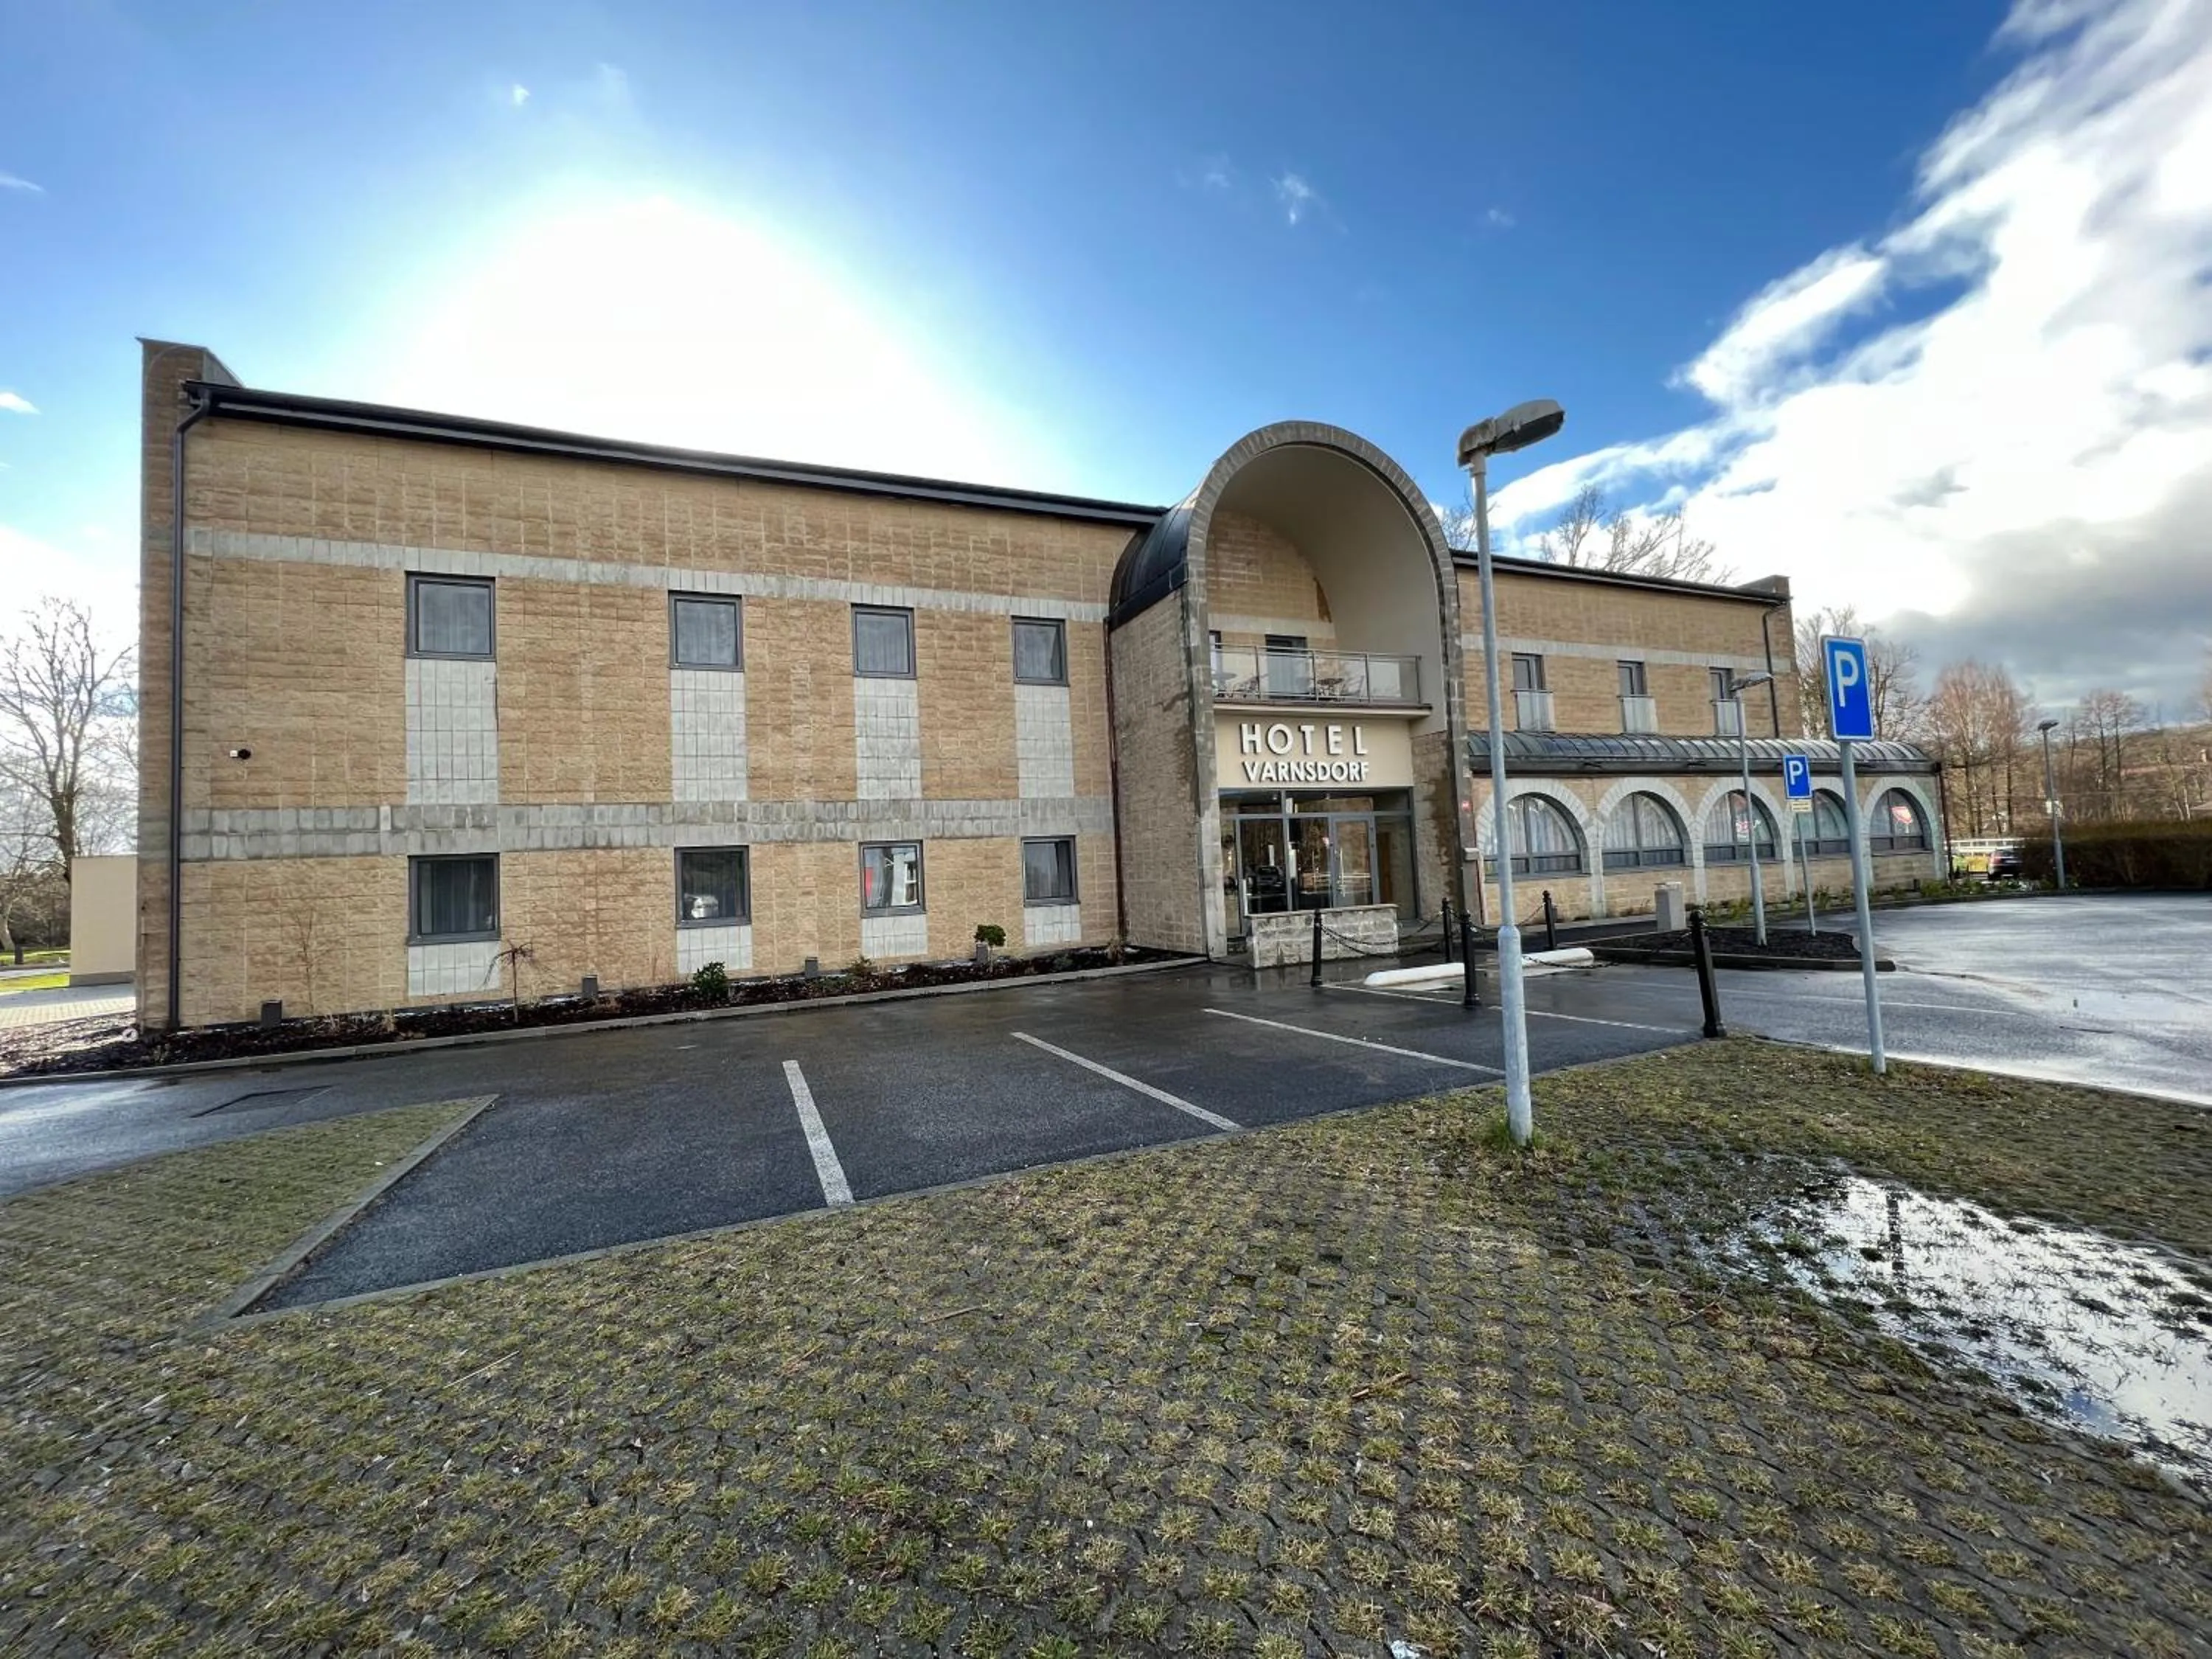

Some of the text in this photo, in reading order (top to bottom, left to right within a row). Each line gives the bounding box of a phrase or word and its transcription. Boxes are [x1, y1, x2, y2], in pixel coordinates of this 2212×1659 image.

[1834, 650, 1859, 708] P
[1240, 723, 1368, 755] HOTEL
[1242, 760, 1369, 782] VARNSDORF
[1788, 760, 1804, 786] P
